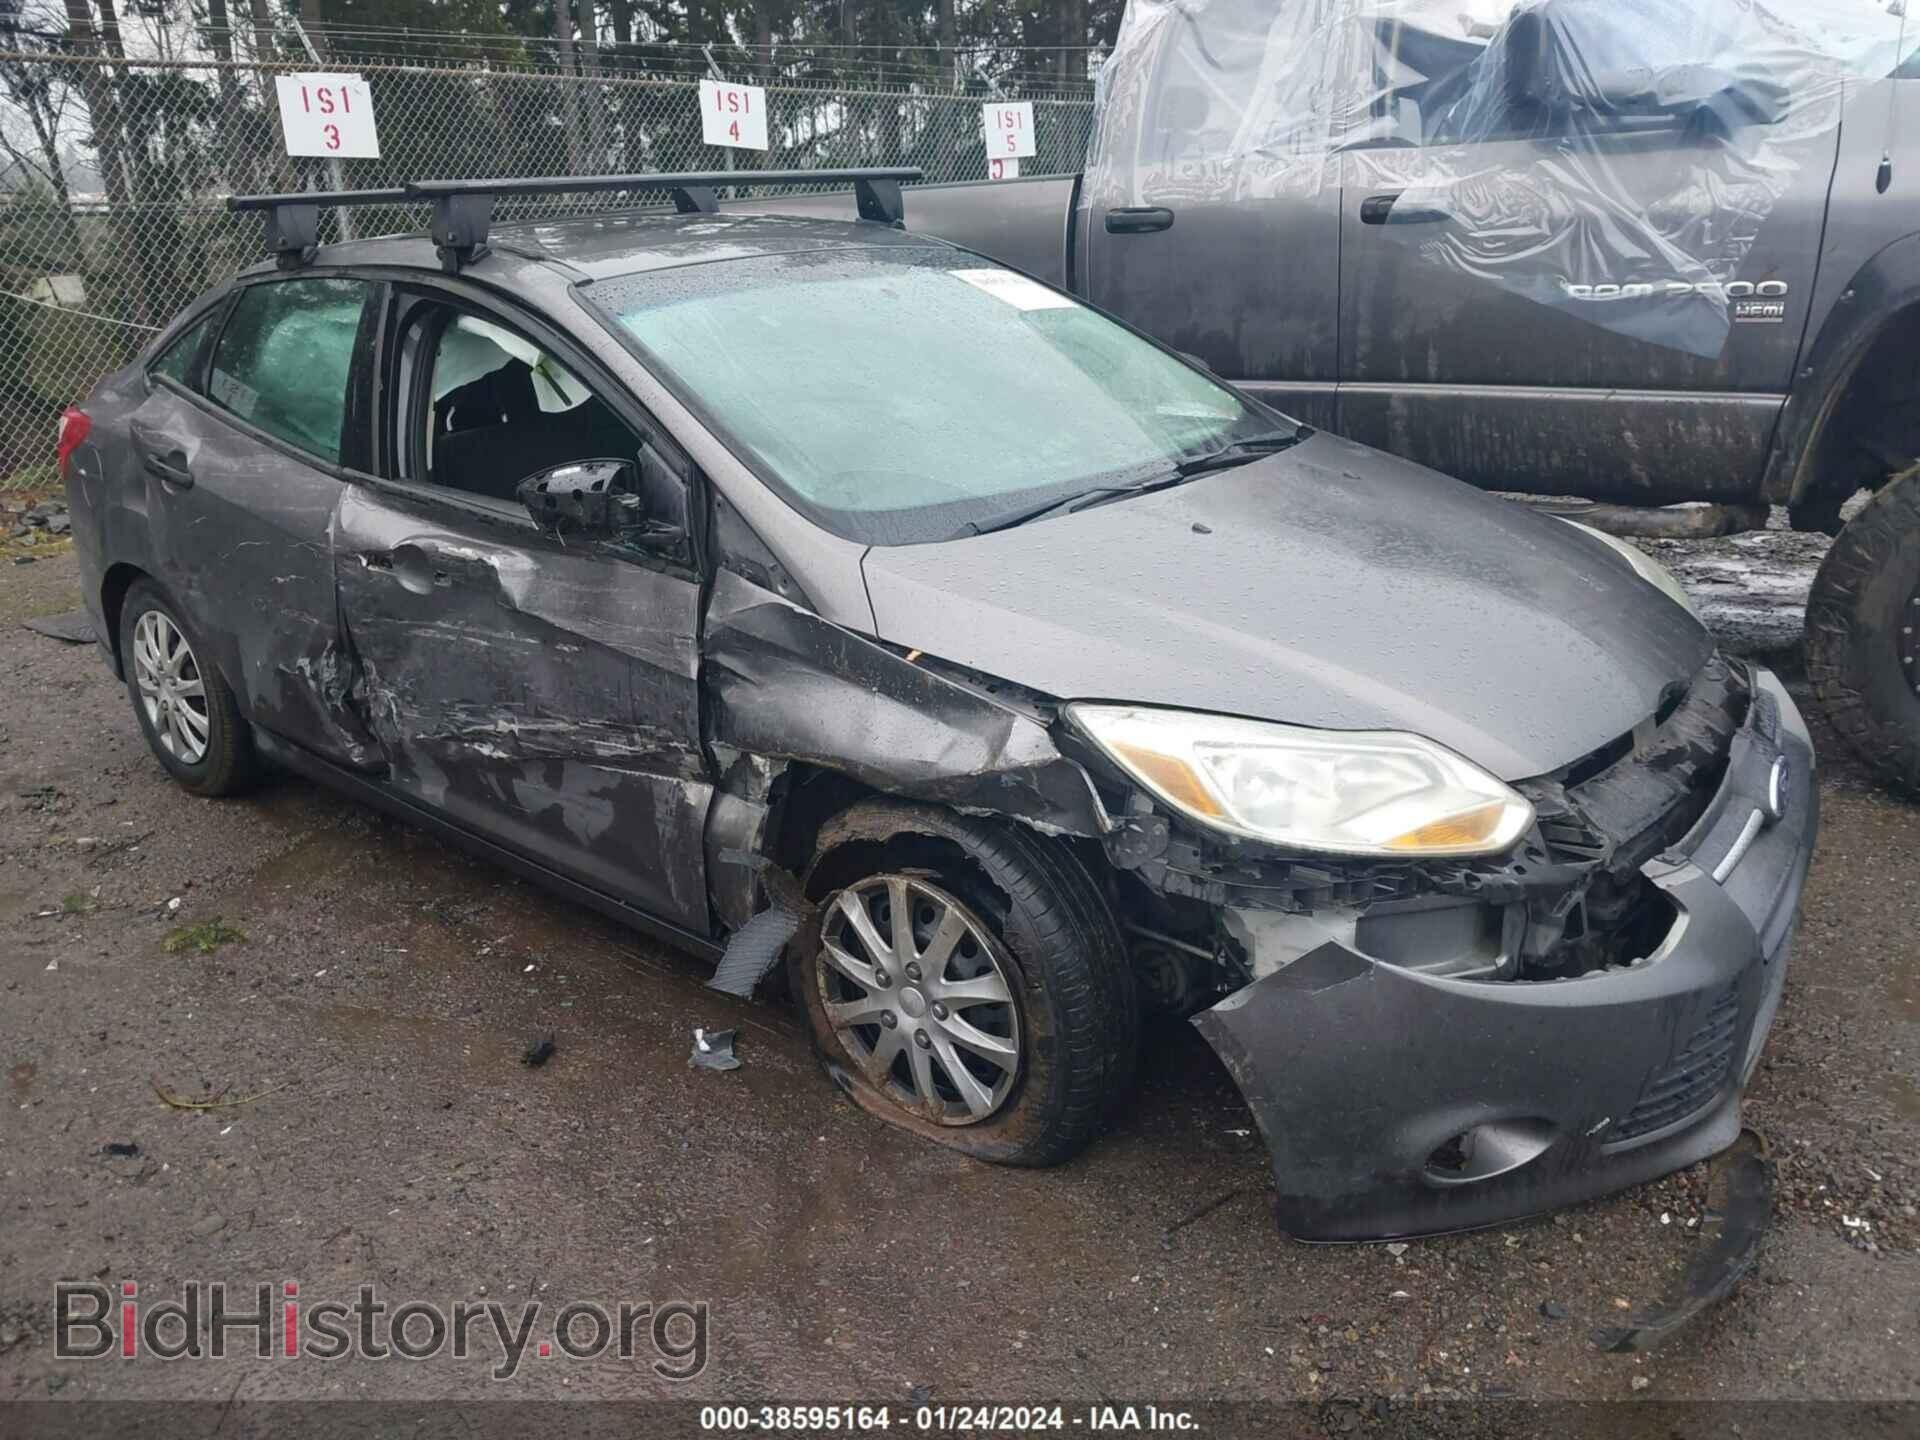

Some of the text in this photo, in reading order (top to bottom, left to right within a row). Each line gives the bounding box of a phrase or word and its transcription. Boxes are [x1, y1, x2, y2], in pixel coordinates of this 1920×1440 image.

[324, 124, 341, 150] 3
[729, 120, 739, 142] 4
[1007, 134, 1016, 152] 5
